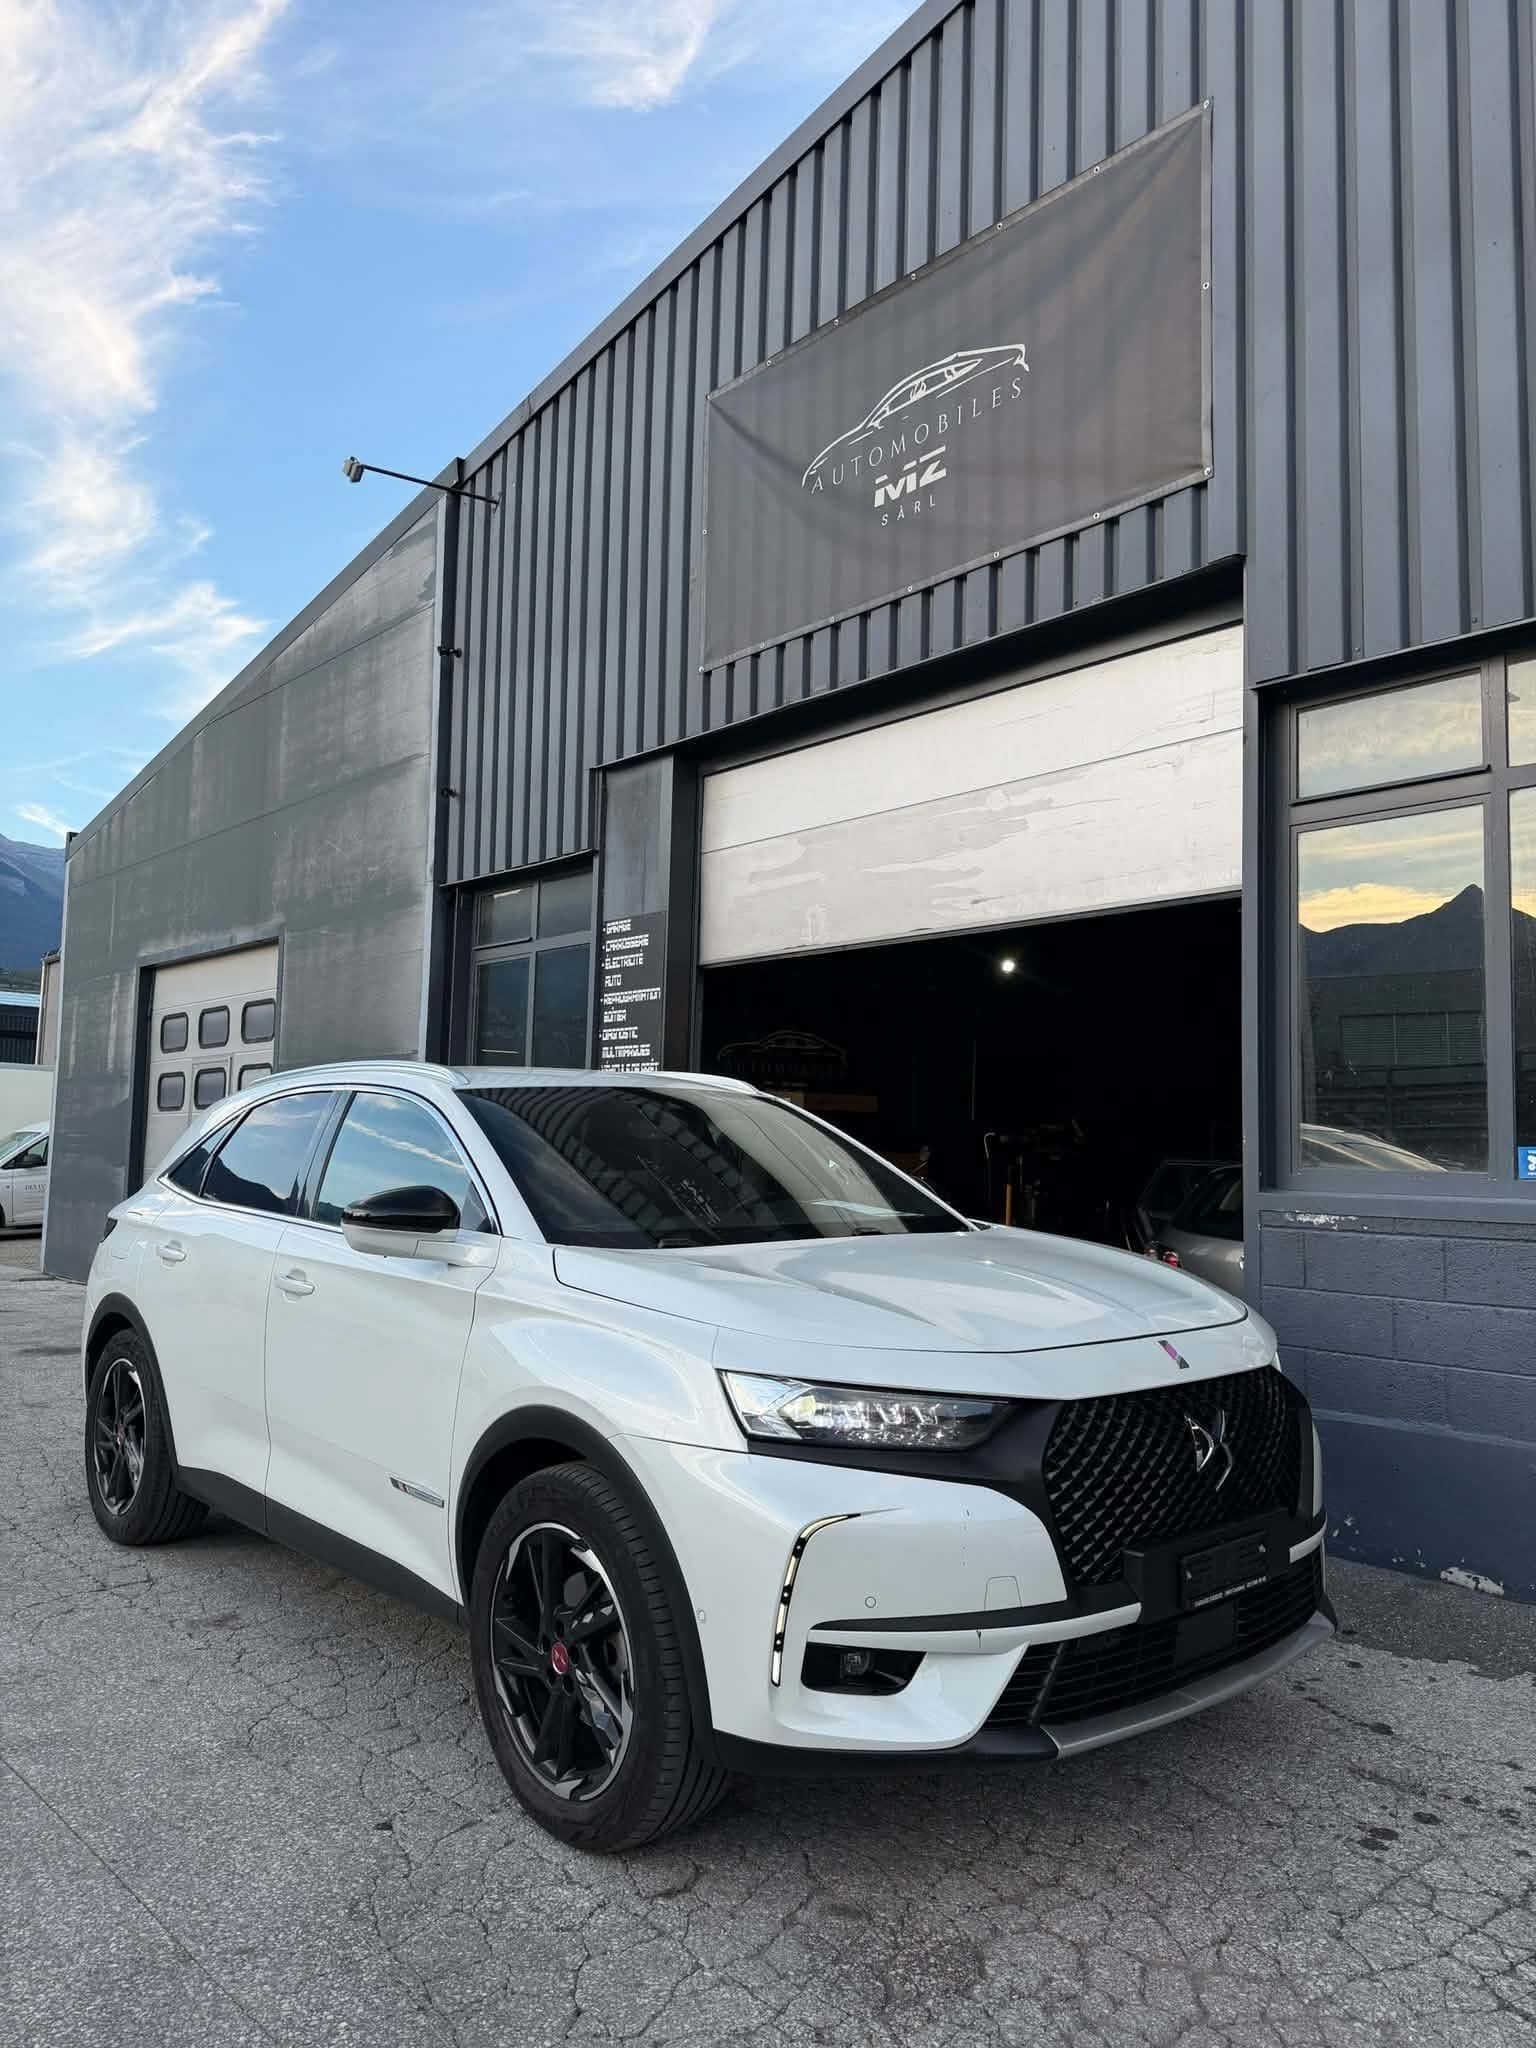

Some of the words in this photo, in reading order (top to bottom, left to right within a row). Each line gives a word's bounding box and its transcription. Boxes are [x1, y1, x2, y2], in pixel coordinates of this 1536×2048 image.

[811, 377, 1021, 494] AUTOMOBILES
[873, 445, 947, 508] MZ
[604, 974, 622, 987] AUTO
